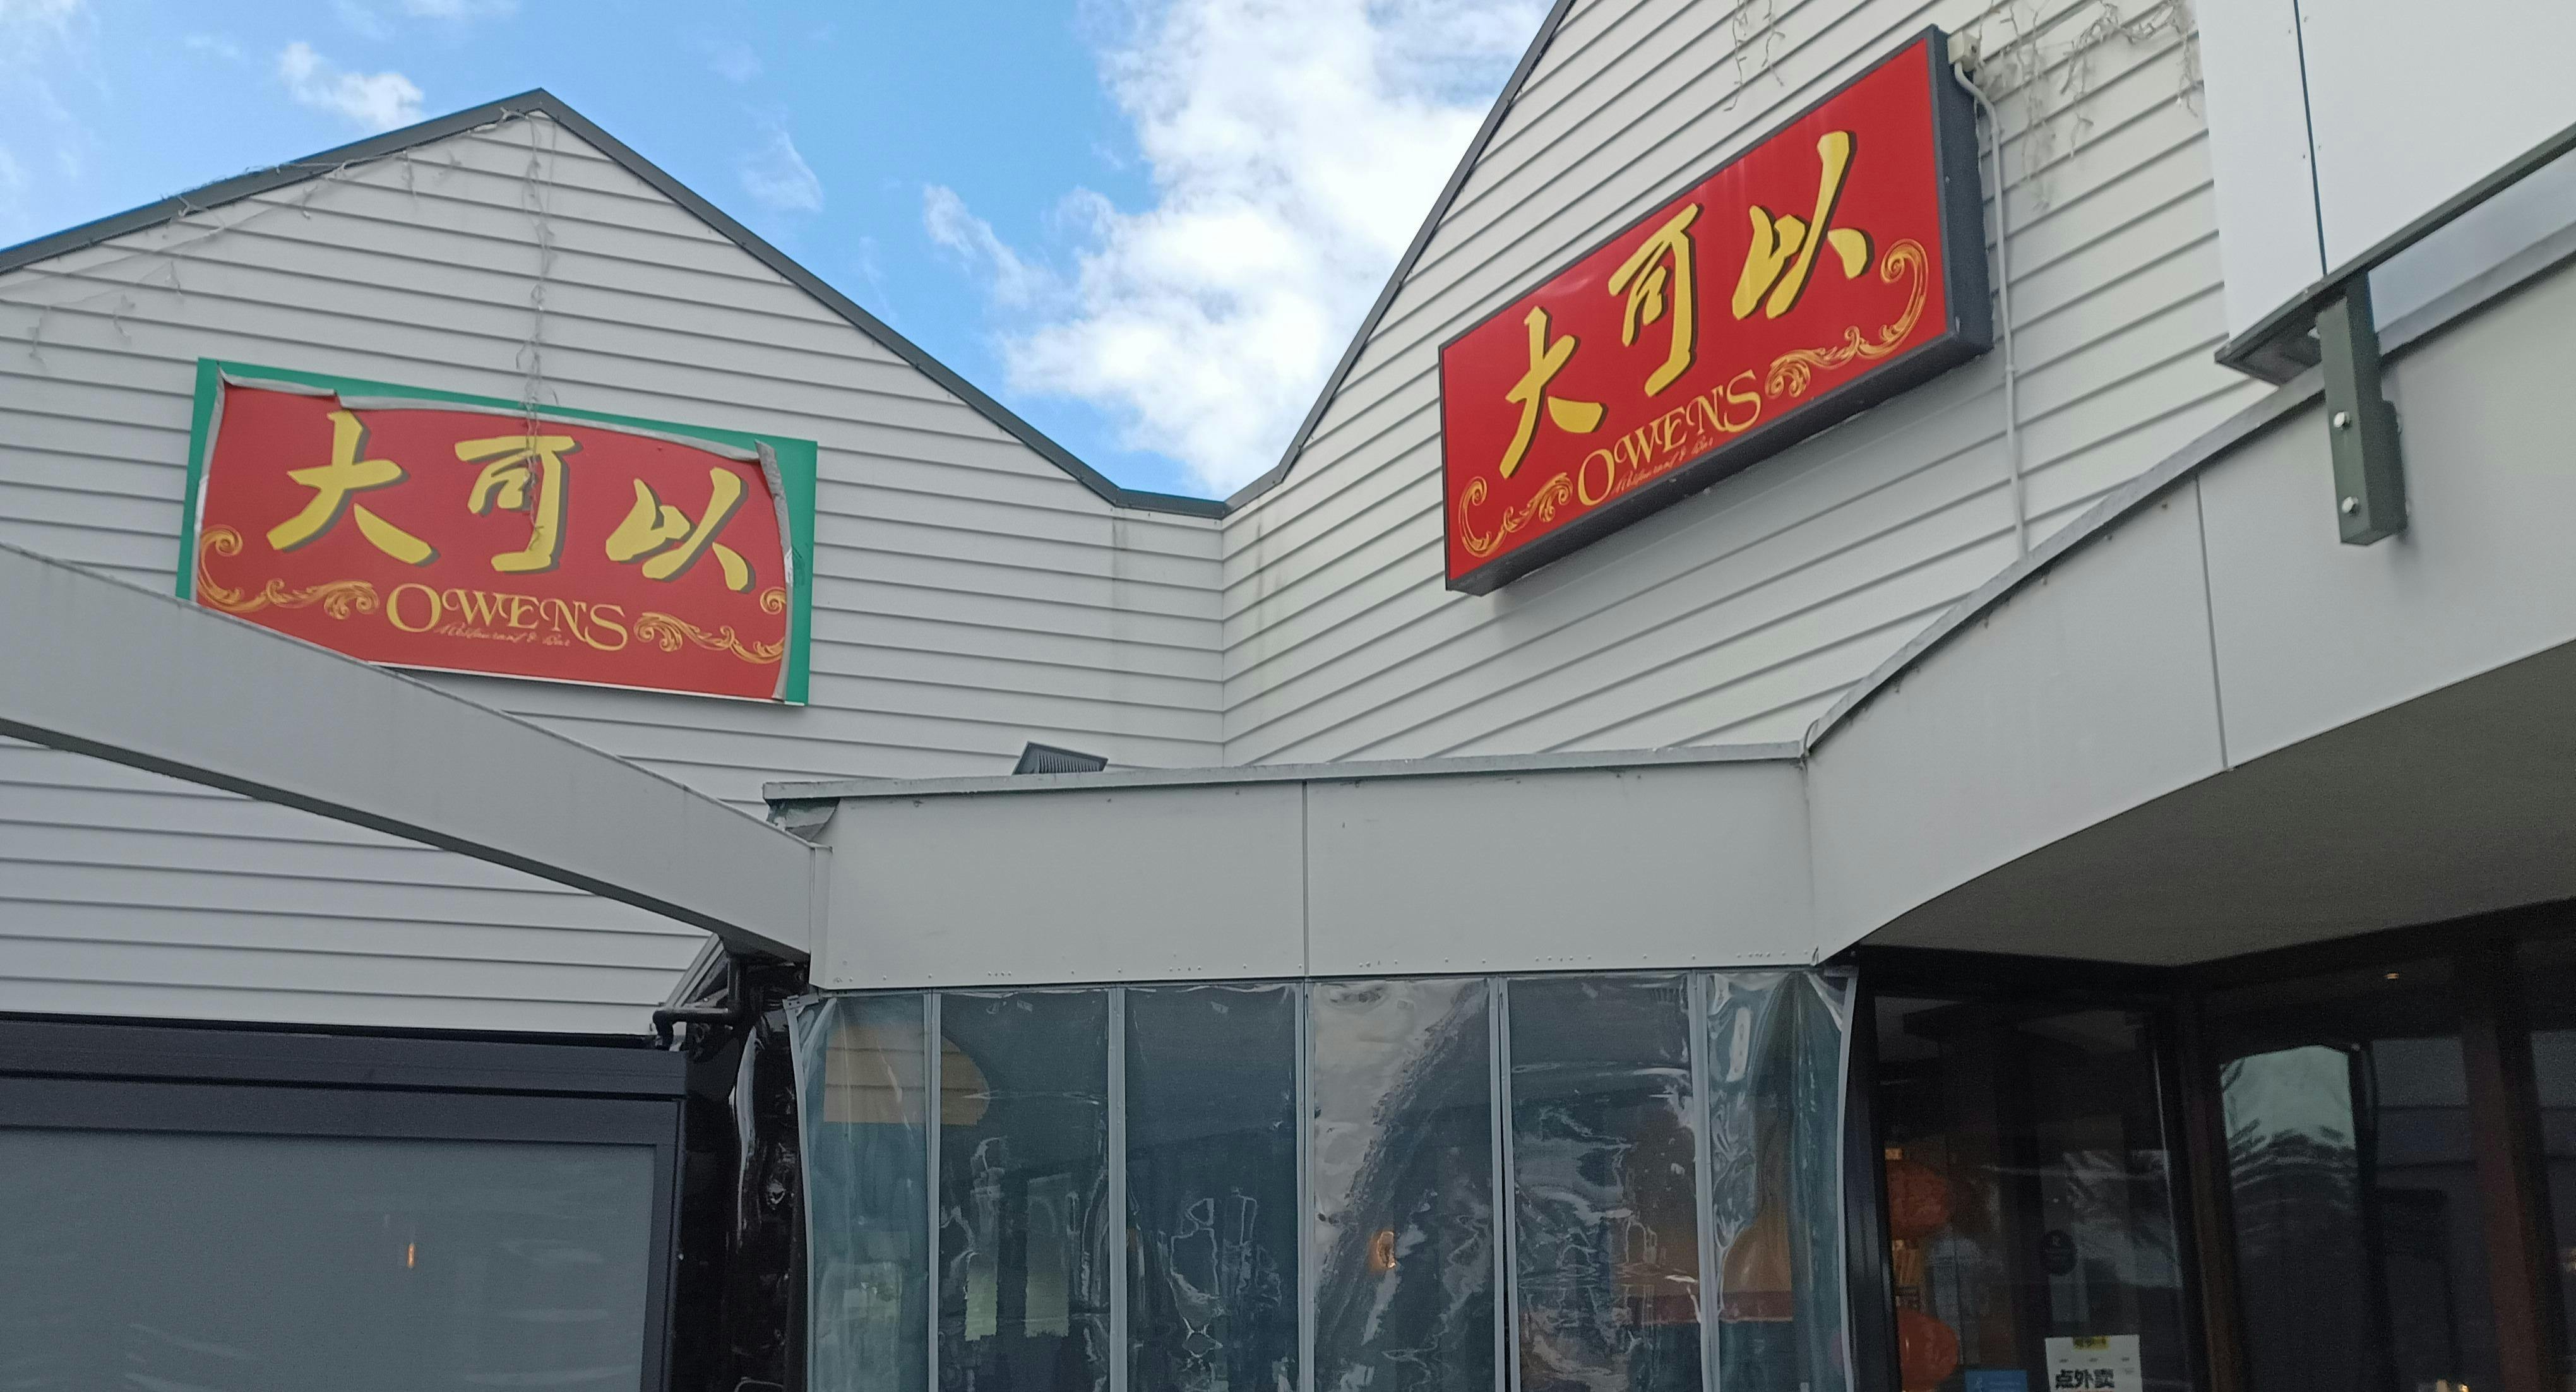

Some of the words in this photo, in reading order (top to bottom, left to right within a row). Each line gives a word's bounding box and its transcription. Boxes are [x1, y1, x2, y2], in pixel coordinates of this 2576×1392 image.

[1500, 131, 1870, 479] 大可以
[267, 410, 750, 592] 大可以
[2055, 1368, 2115, 1389] 点外卖
